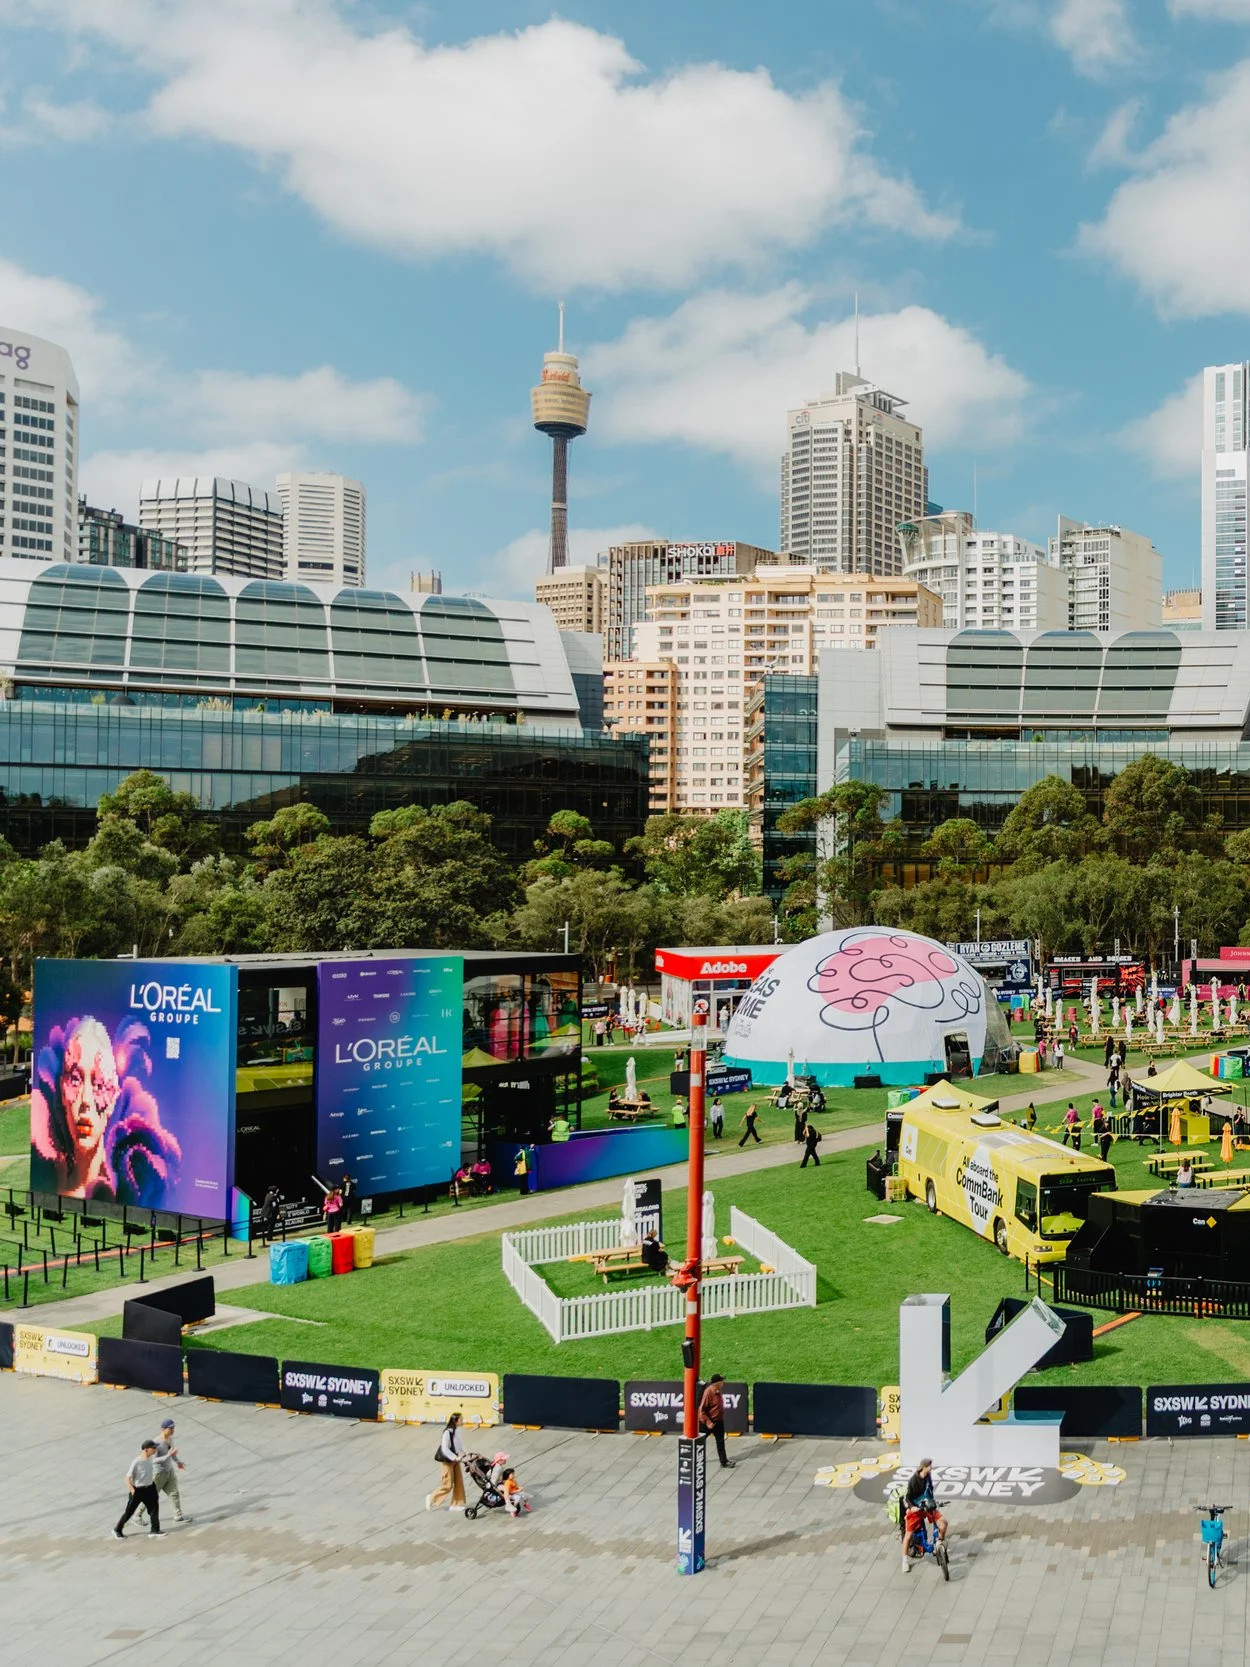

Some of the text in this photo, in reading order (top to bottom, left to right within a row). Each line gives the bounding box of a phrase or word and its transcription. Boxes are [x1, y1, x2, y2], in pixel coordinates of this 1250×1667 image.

[960, 944, 980, 953] RYAN
[701, 961, 747, 974] Adobe
[129, 981, 221, 1012] L'ORÉAL
[150, 1012, 199, 1025] GROUPE
[335, 1035, 448, 1063] L'ORÉAL
[363, 1058, 423, 1071] GROUPE
[970, 1160, 989, 1178] aboard
[990, 1169, 999, 1183] the
[956, 1168, 1003, 1208] CommBank
[970, 1195, 988, 1220] Tour
[19, 1330, 39, 1341] SXSW
[19, 1340, 44, 1351] SYDNEY
[57, 1341, 86, 1351] UNLOCKED
[285, 1372, 372, 1396] SXSW SYDNEY
[388, 1376, 416, 1386] SXSW
[444, 1383, 485, 1392] UNLOCKED
[388, 1386, 424, 1396] SYDNEY
[630, 1393, 670, 1408] SXSW
[889, 1394, 901, 1403] SX
[1154, 1397, 1195, 1411] SXSW
[695, 1444, 704, 1535] SXSW SYDNEY
[883, 1481, 1046, 1497] SDNEY
